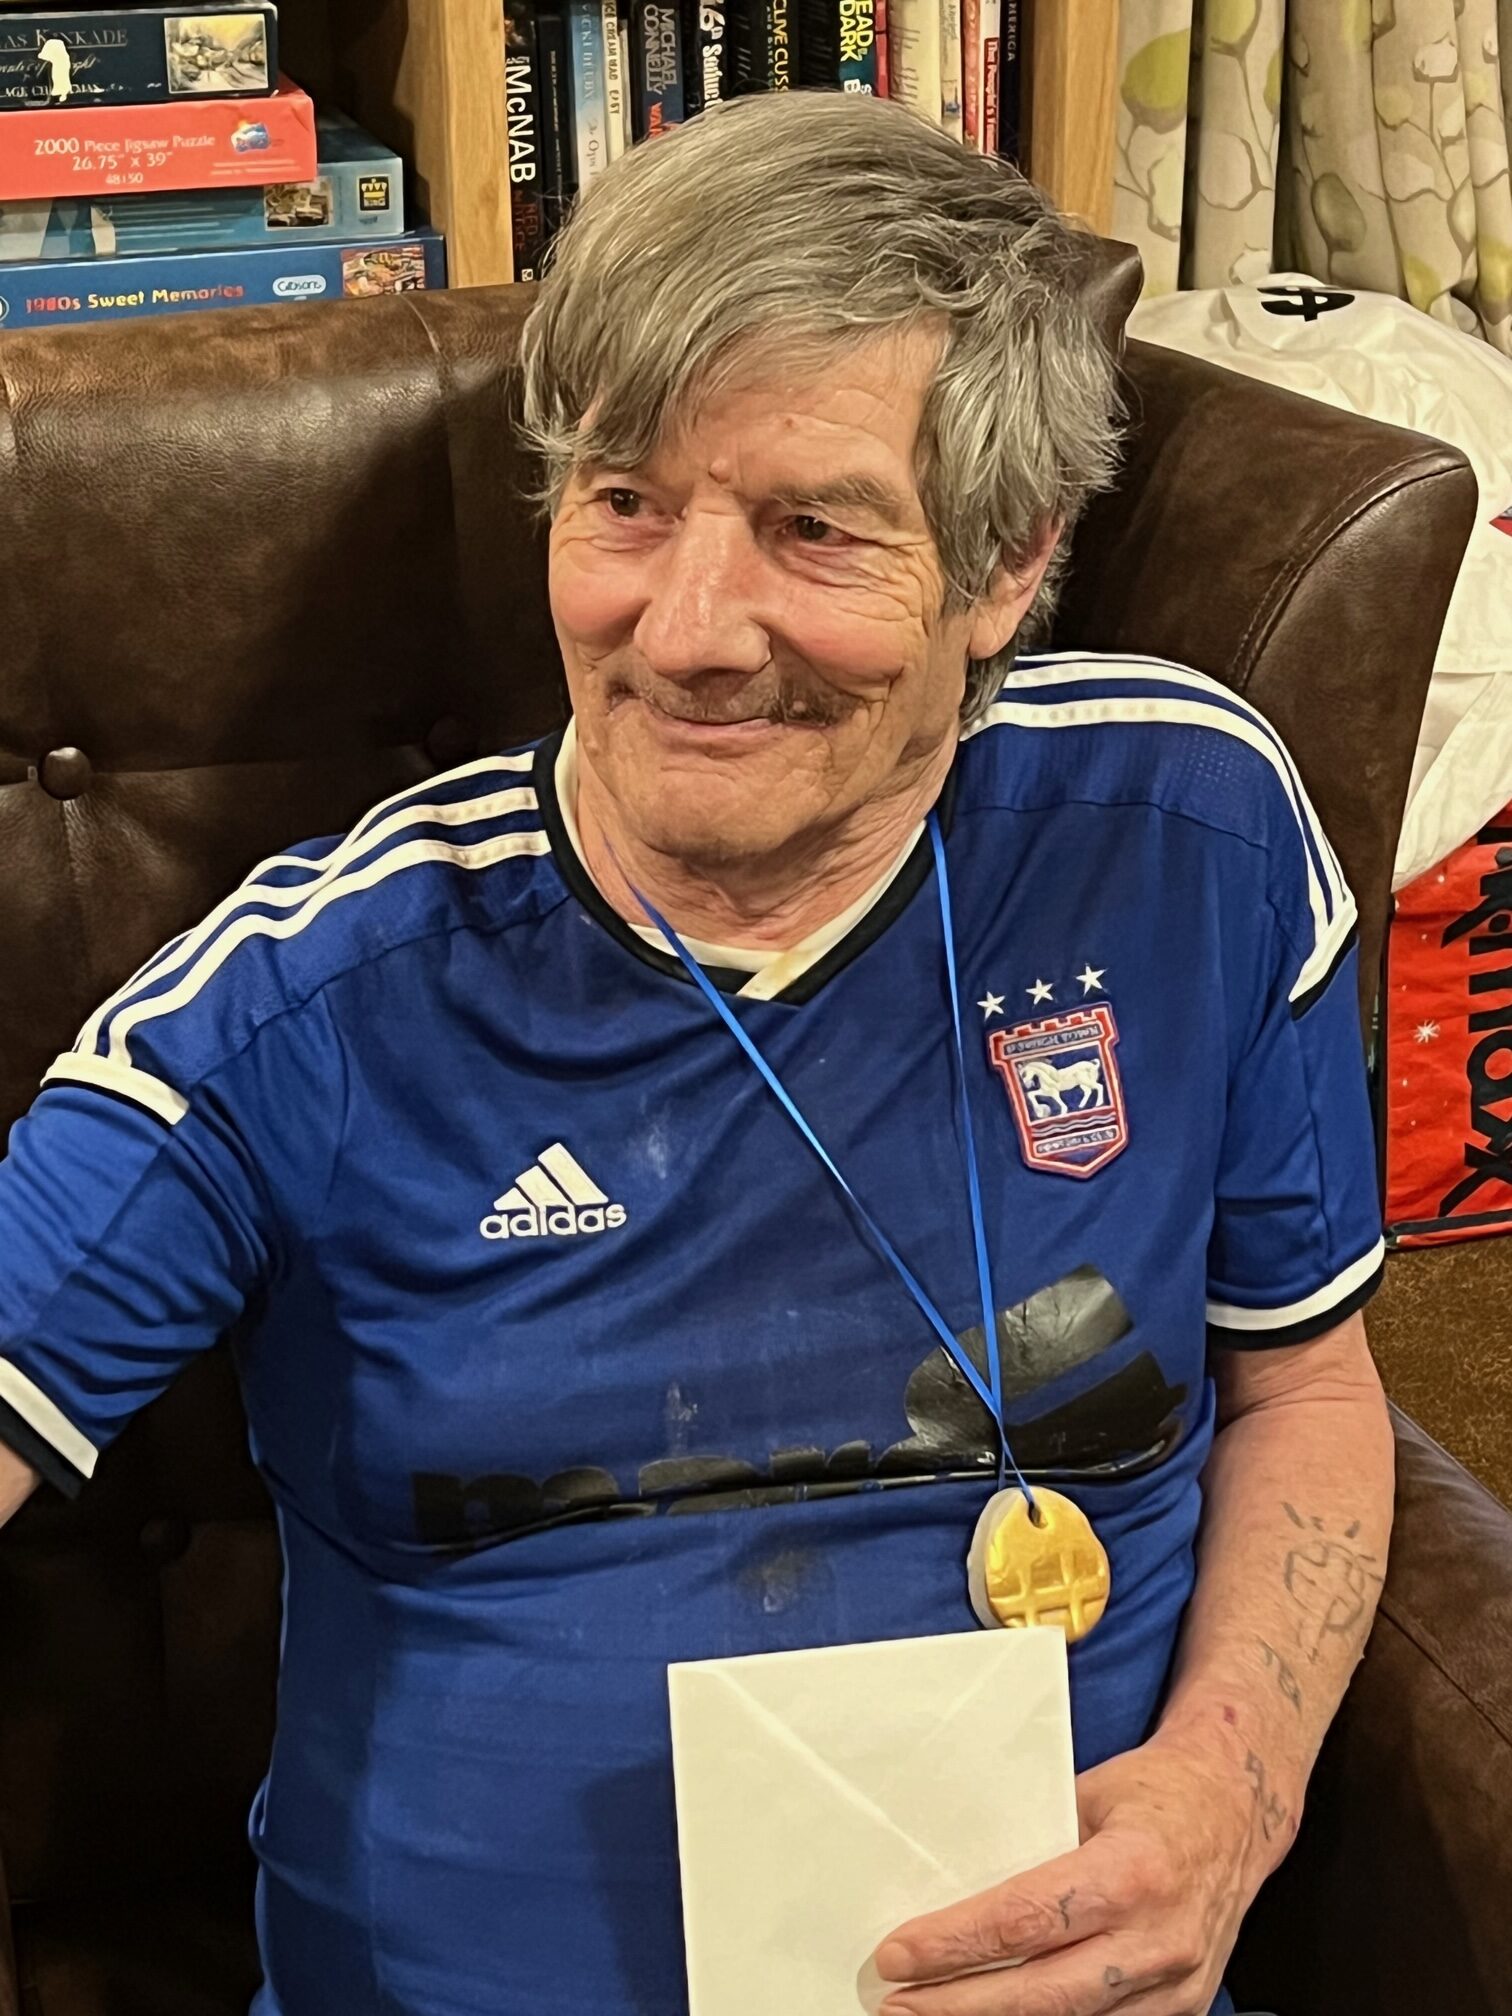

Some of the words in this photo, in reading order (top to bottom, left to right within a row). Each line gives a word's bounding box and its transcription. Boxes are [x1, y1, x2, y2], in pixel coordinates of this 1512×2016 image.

[773, 0, 788, 45] CLIVE
[643, 4, 667, 95] CONNELLY
[658, 8, 677, 85] MICHAEL
[33, 137, 79, 156] 2000
[84, 140, 120, 152] Piece
[125, 137, 169, 154] Jigsaw
[172, 135, 216, 148] Puzzle
[505, 65, 537, 183] McNAB
[87, 290, 145, 309] Sweet
[152, 284, 245, 303] Memories
[479, 1202, 628, 1240] adidas
